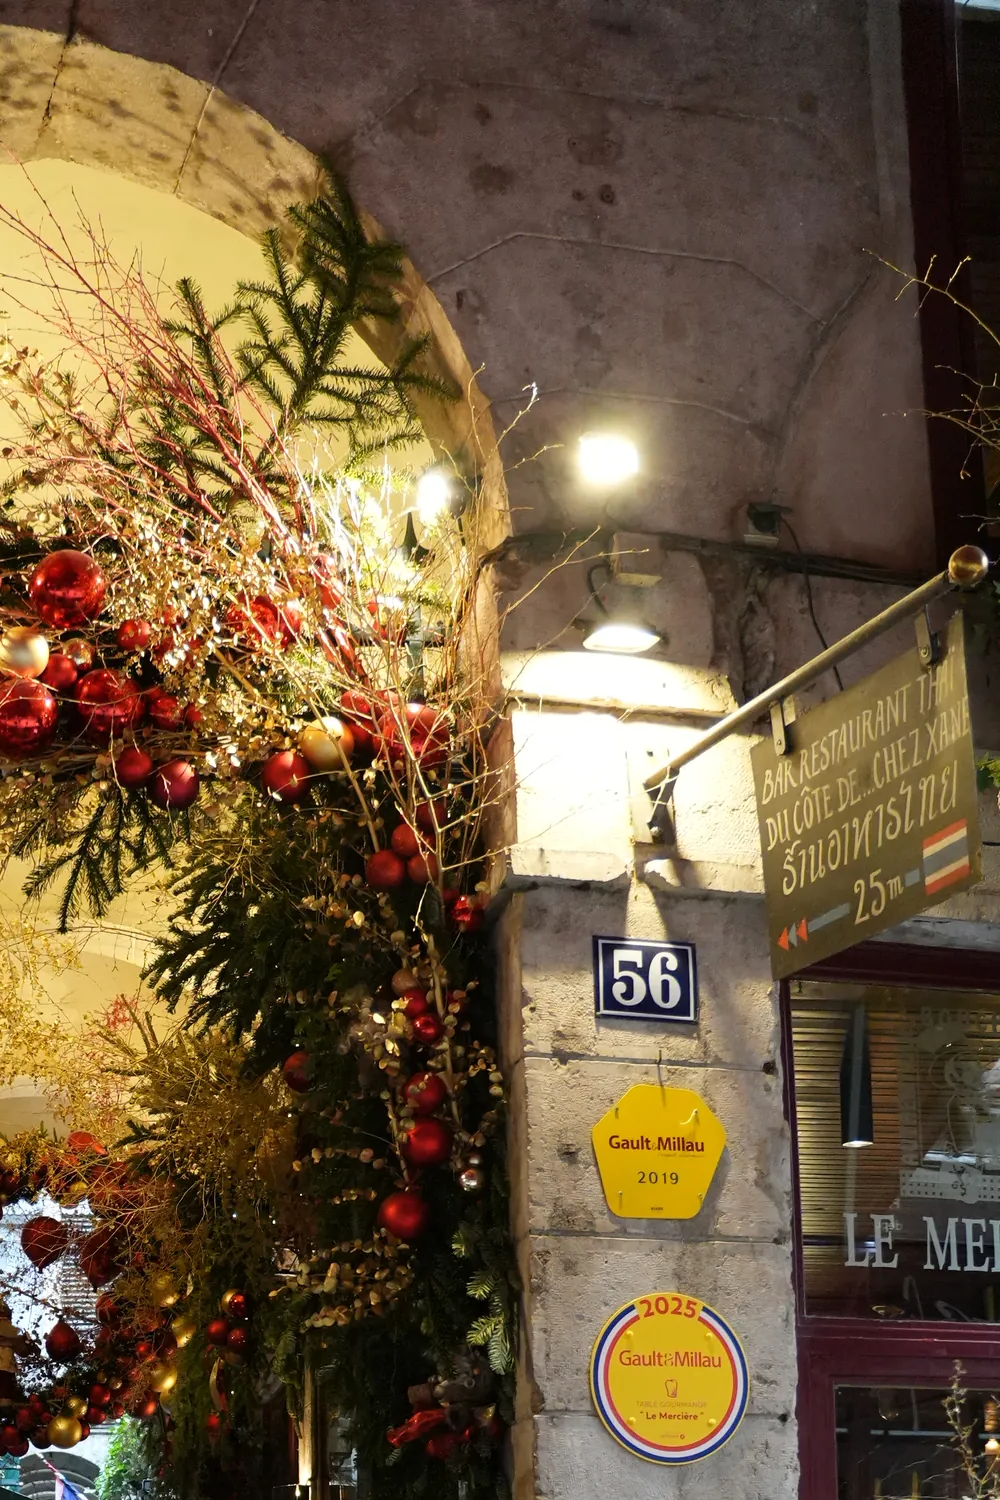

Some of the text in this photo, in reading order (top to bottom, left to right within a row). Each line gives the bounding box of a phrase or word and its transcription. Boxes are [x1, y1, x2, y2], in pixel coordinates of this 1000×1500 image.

[762, 757, 797, 805] BAR
[800, 683, 911, 784] RESTAURANT
[765, 812, 790, 851] DU
[873, 730, 927, 789] CHEZ
[612, 949, 682, 1009] 56
[608, 1135, 705, 1152] Gault&Millau
[637, 1171, 679, 1185] 2019
[843, 1212, 899, 1270] LE
[639, 1296, 698, 1319] 2025
